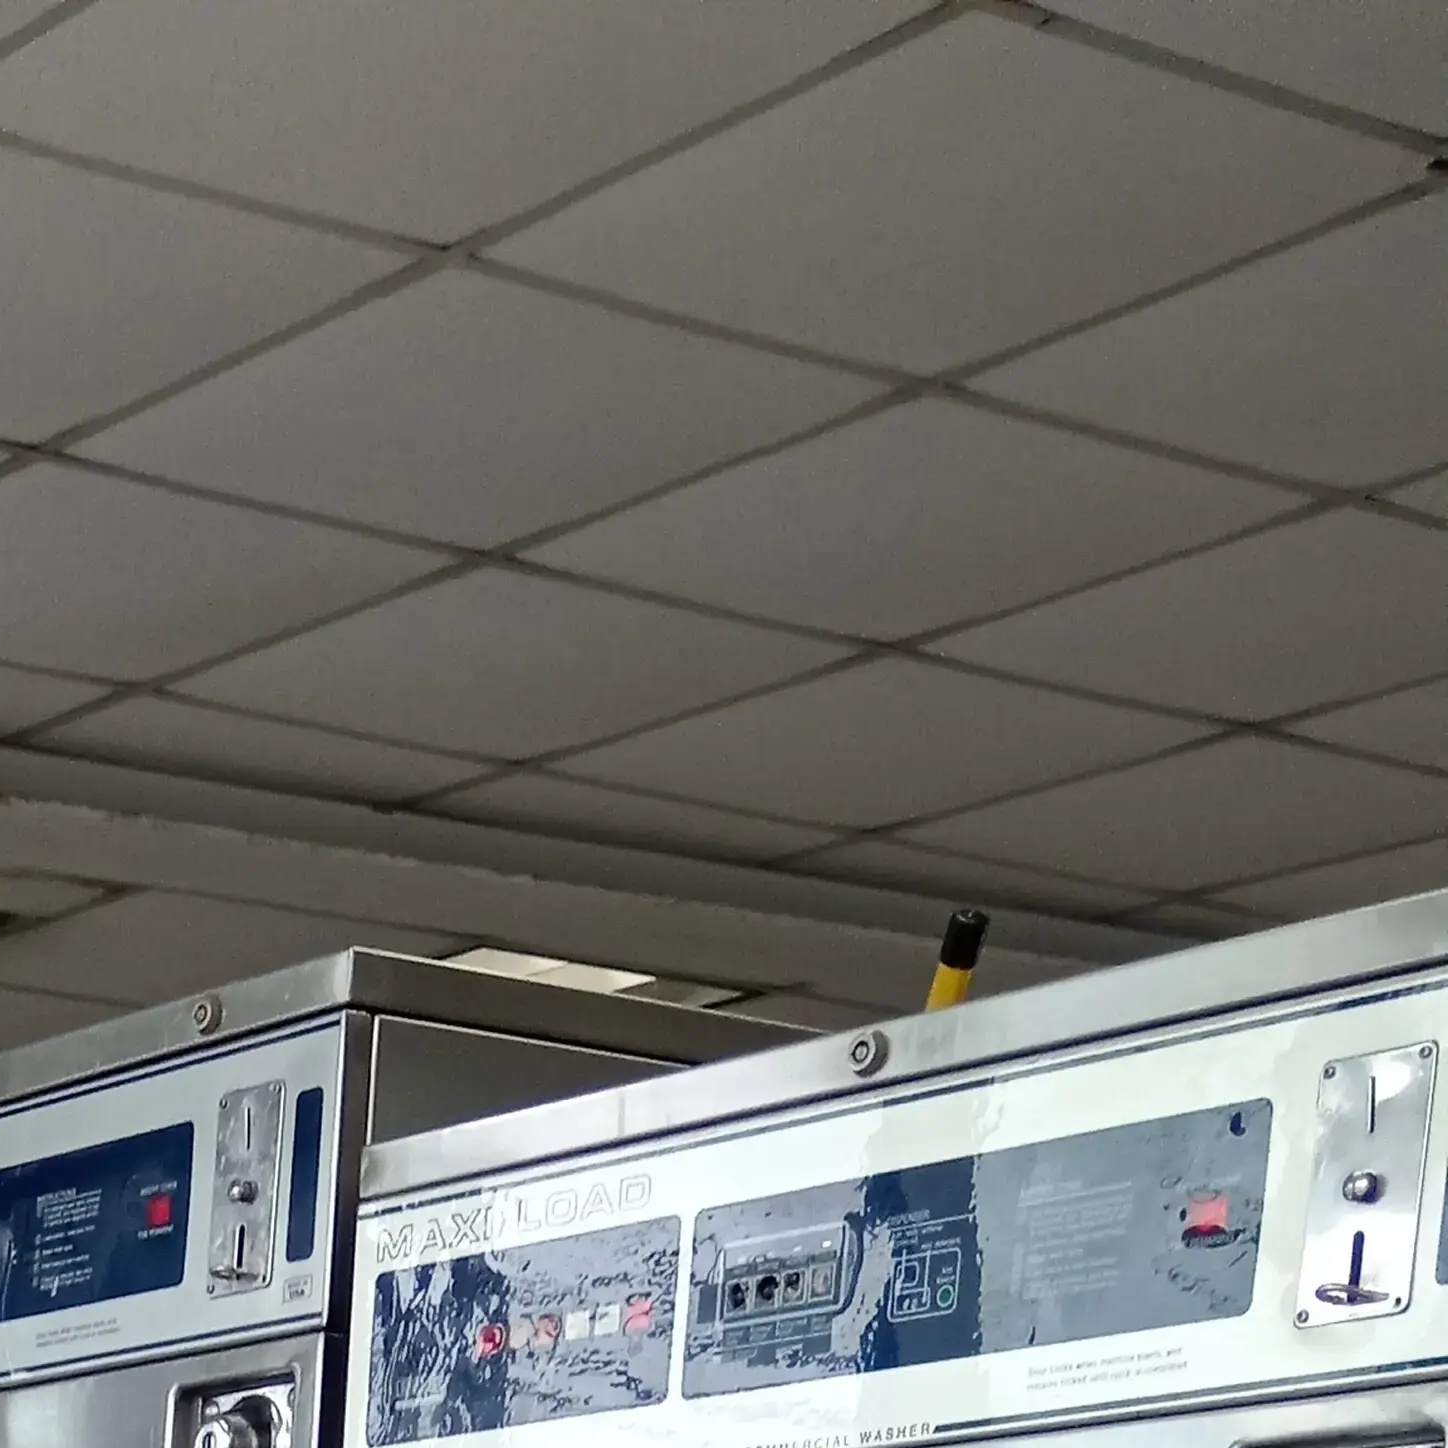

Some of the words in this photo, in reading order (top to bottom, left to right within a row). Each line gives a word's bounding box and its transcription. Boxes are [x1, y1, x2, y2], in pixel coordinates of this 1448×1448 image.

[376, 1205, 504, 1263] MAXI
[516, 1174, 651, 1233] LOAD
[859, 1422, 930, 1445] WASHER
